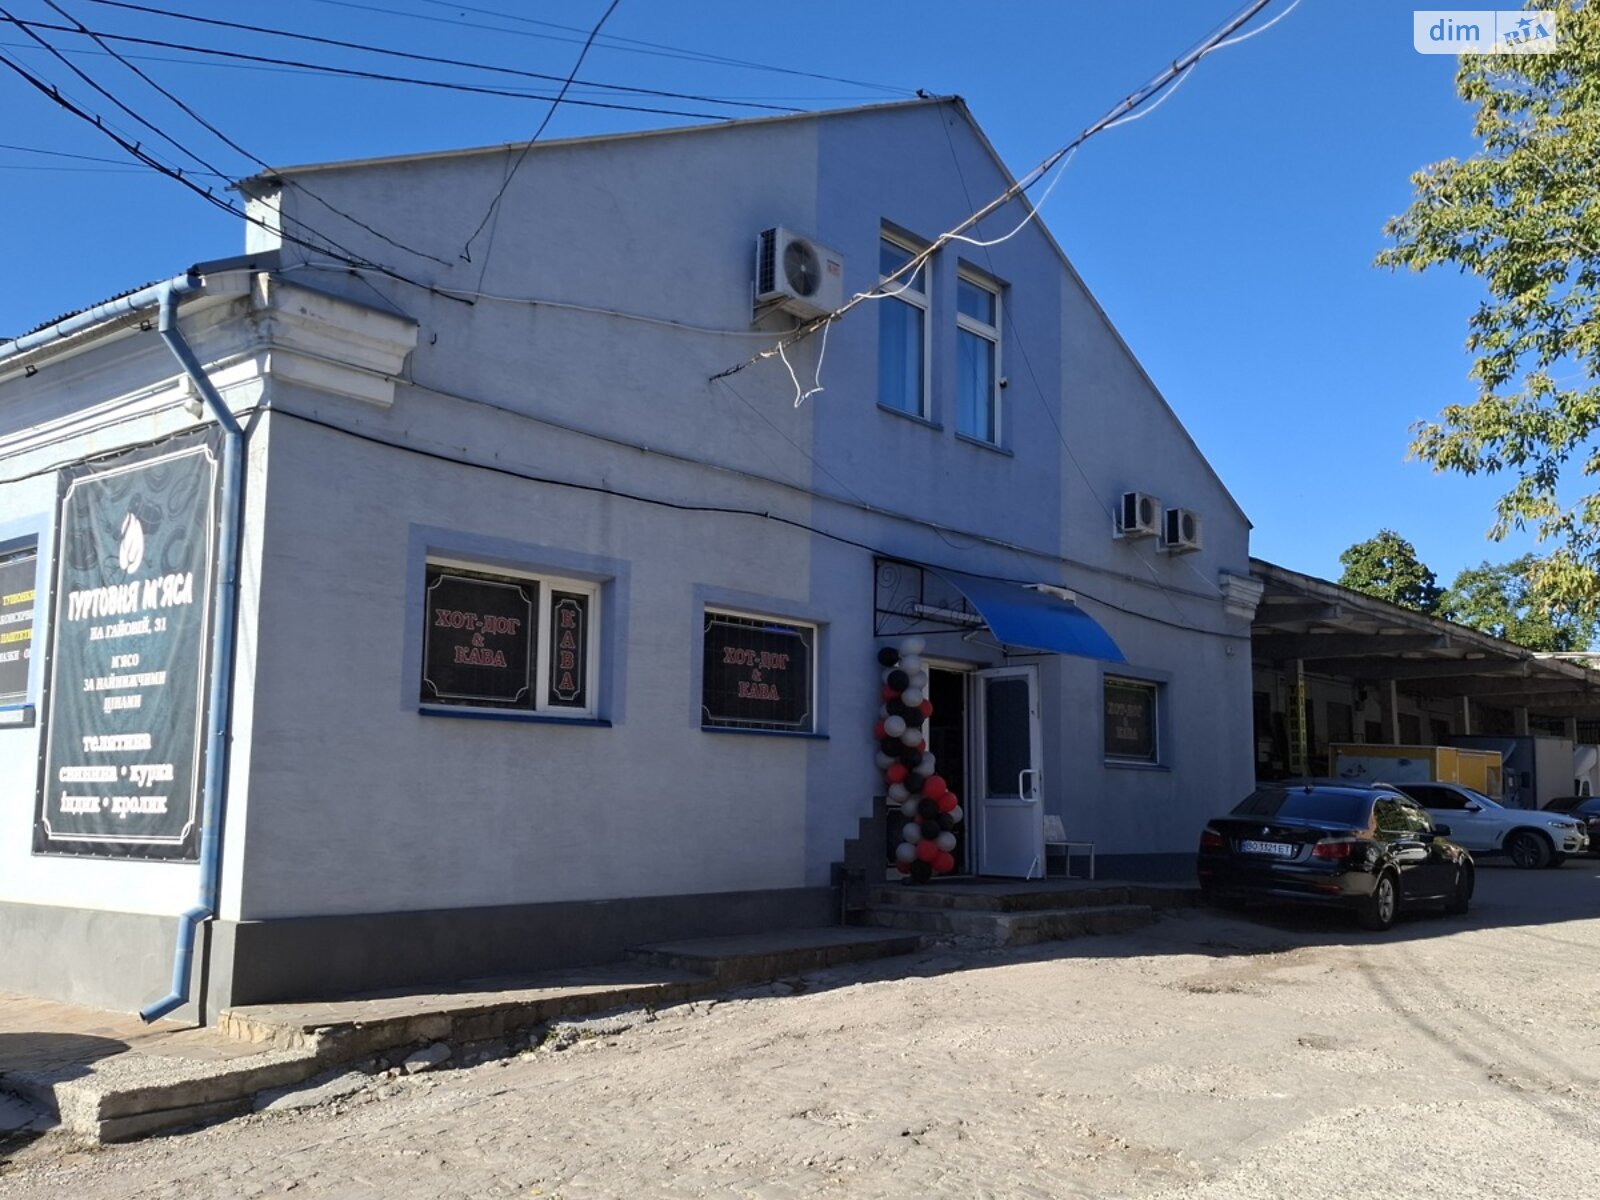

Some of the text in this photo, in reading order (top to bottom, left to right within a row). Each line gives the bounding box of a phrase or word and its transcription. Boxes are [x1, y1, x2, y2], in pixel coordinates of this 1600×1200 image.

[67, 580, 140, 621] ГУРТОВНЯ
[142, 571, 193, 609] М'ЯСА
[153, 616, 167, 633] 31
[435, 608, 521, 635] ХОТ-ДОГ
[472, 632, 485, 647] &
[558, 609, 576, 690] КАВА
[454, 645, 507, 667] КАВА
[723, 646, 790, 670] ХОТ-ДОГ
[83, 678, 95, 691] ЗА
[738, 681, 779, 701] КАВА
